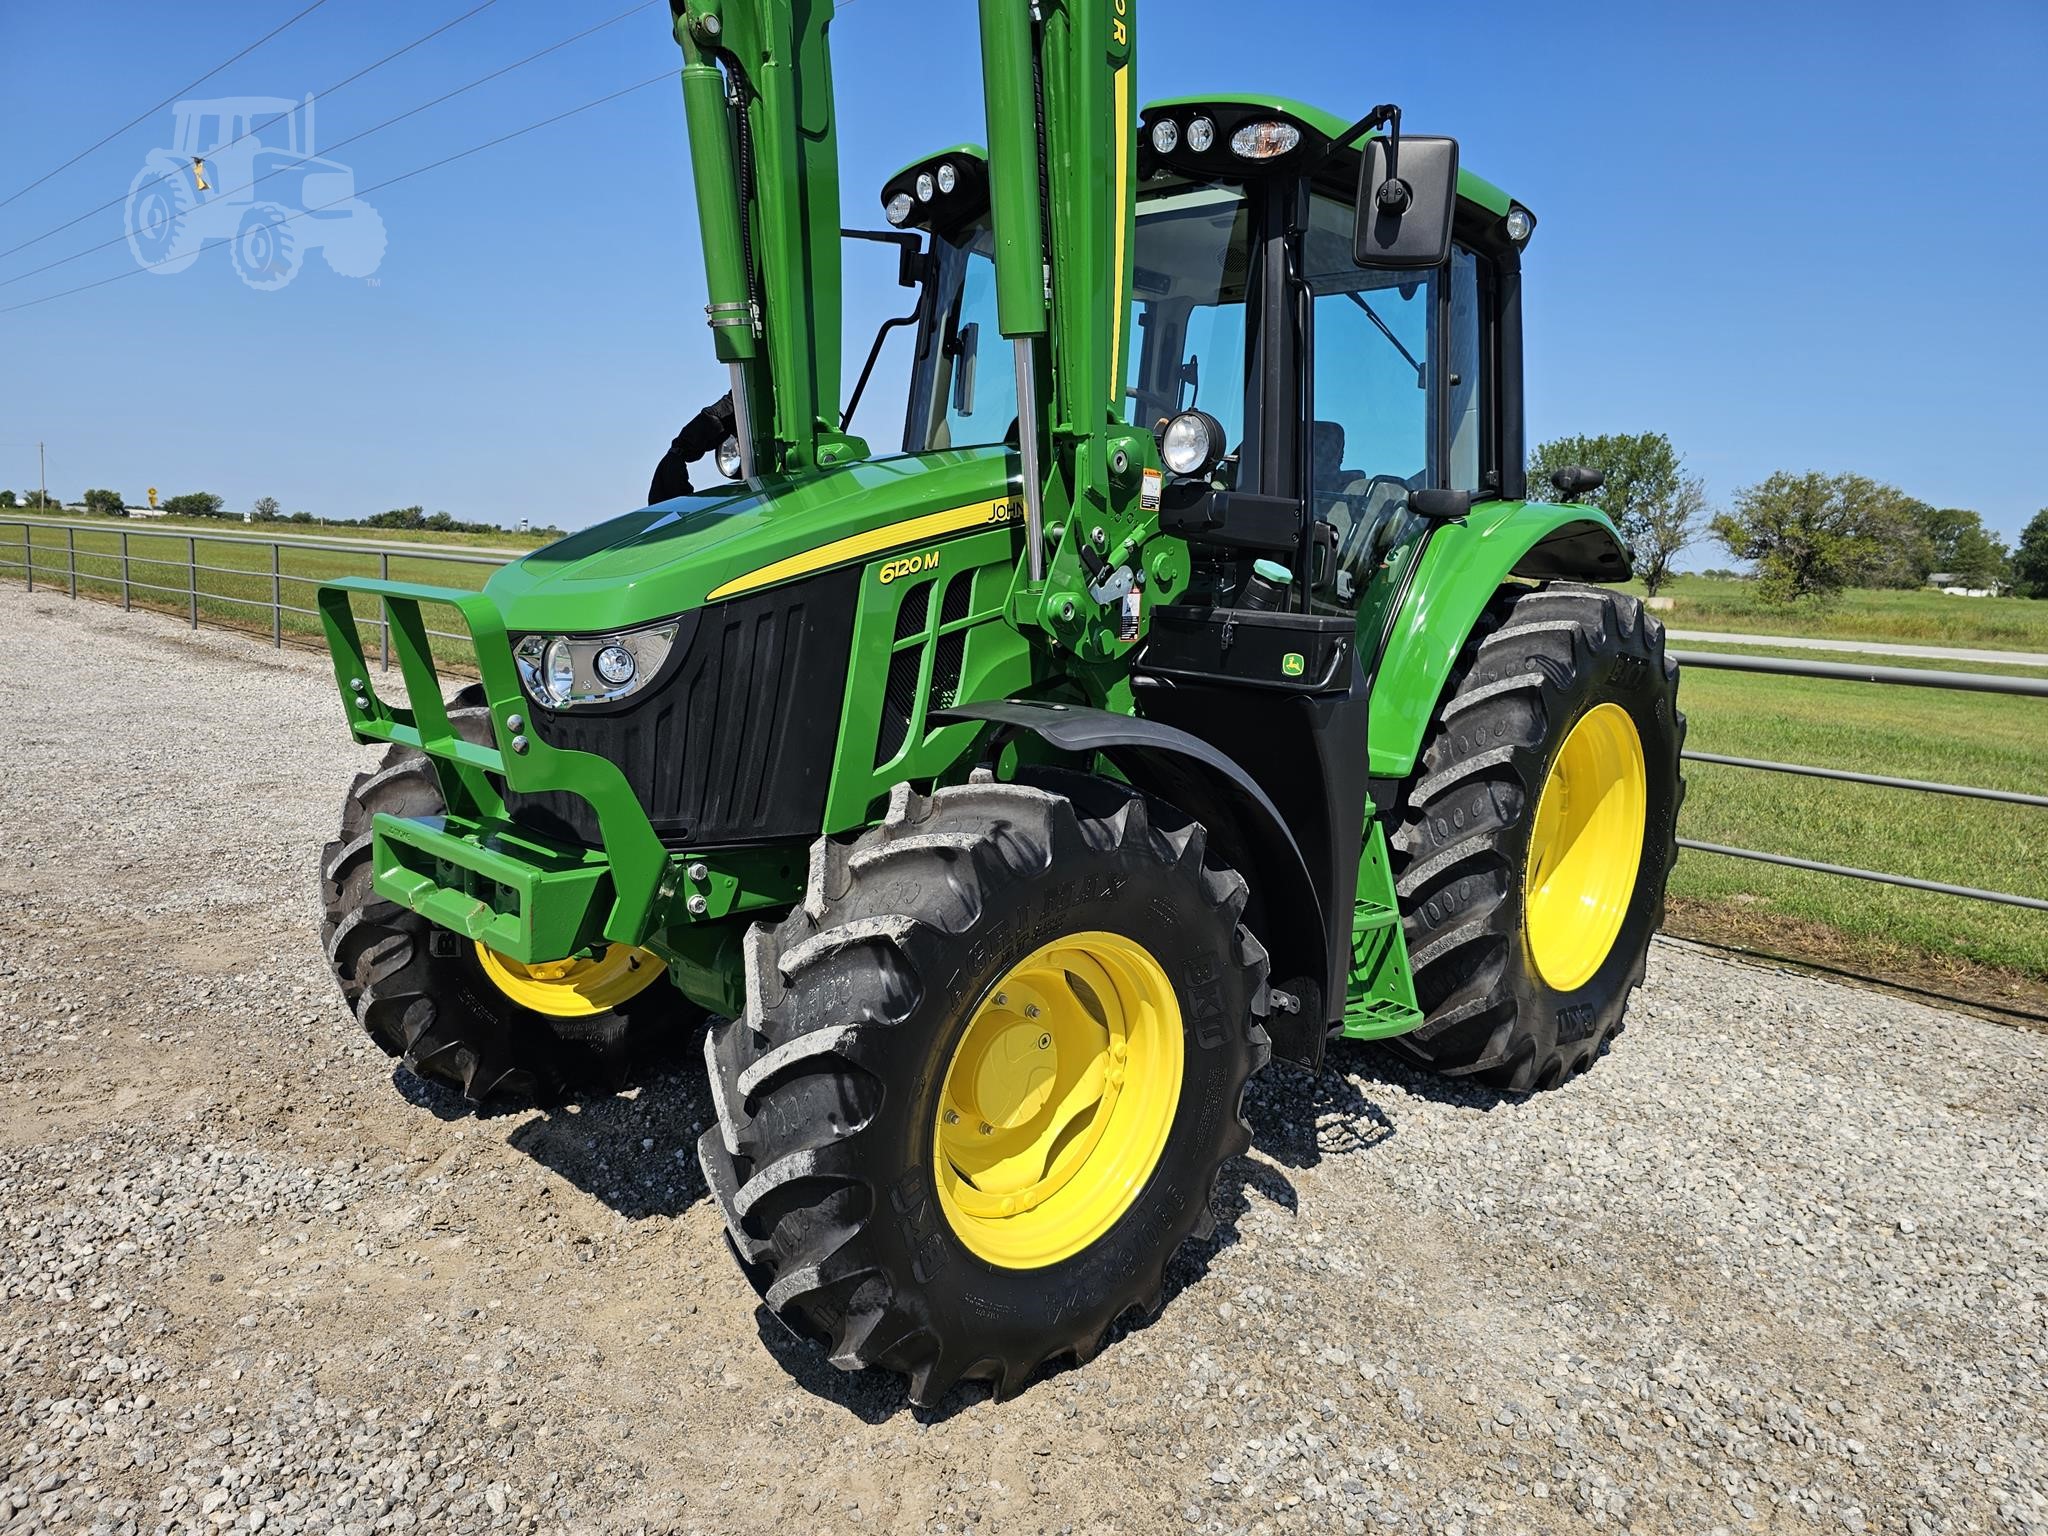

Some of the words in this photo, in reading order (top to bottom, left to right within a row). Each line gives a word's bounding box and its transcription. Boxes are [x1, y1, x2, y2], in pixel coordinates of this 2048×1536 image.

[879, 555, 922, 584] 6120
[924, 551, 940, 571] M
[1183, 955, 1234, 1050] BKT
[888, 1163, 951, 1284] BKT
